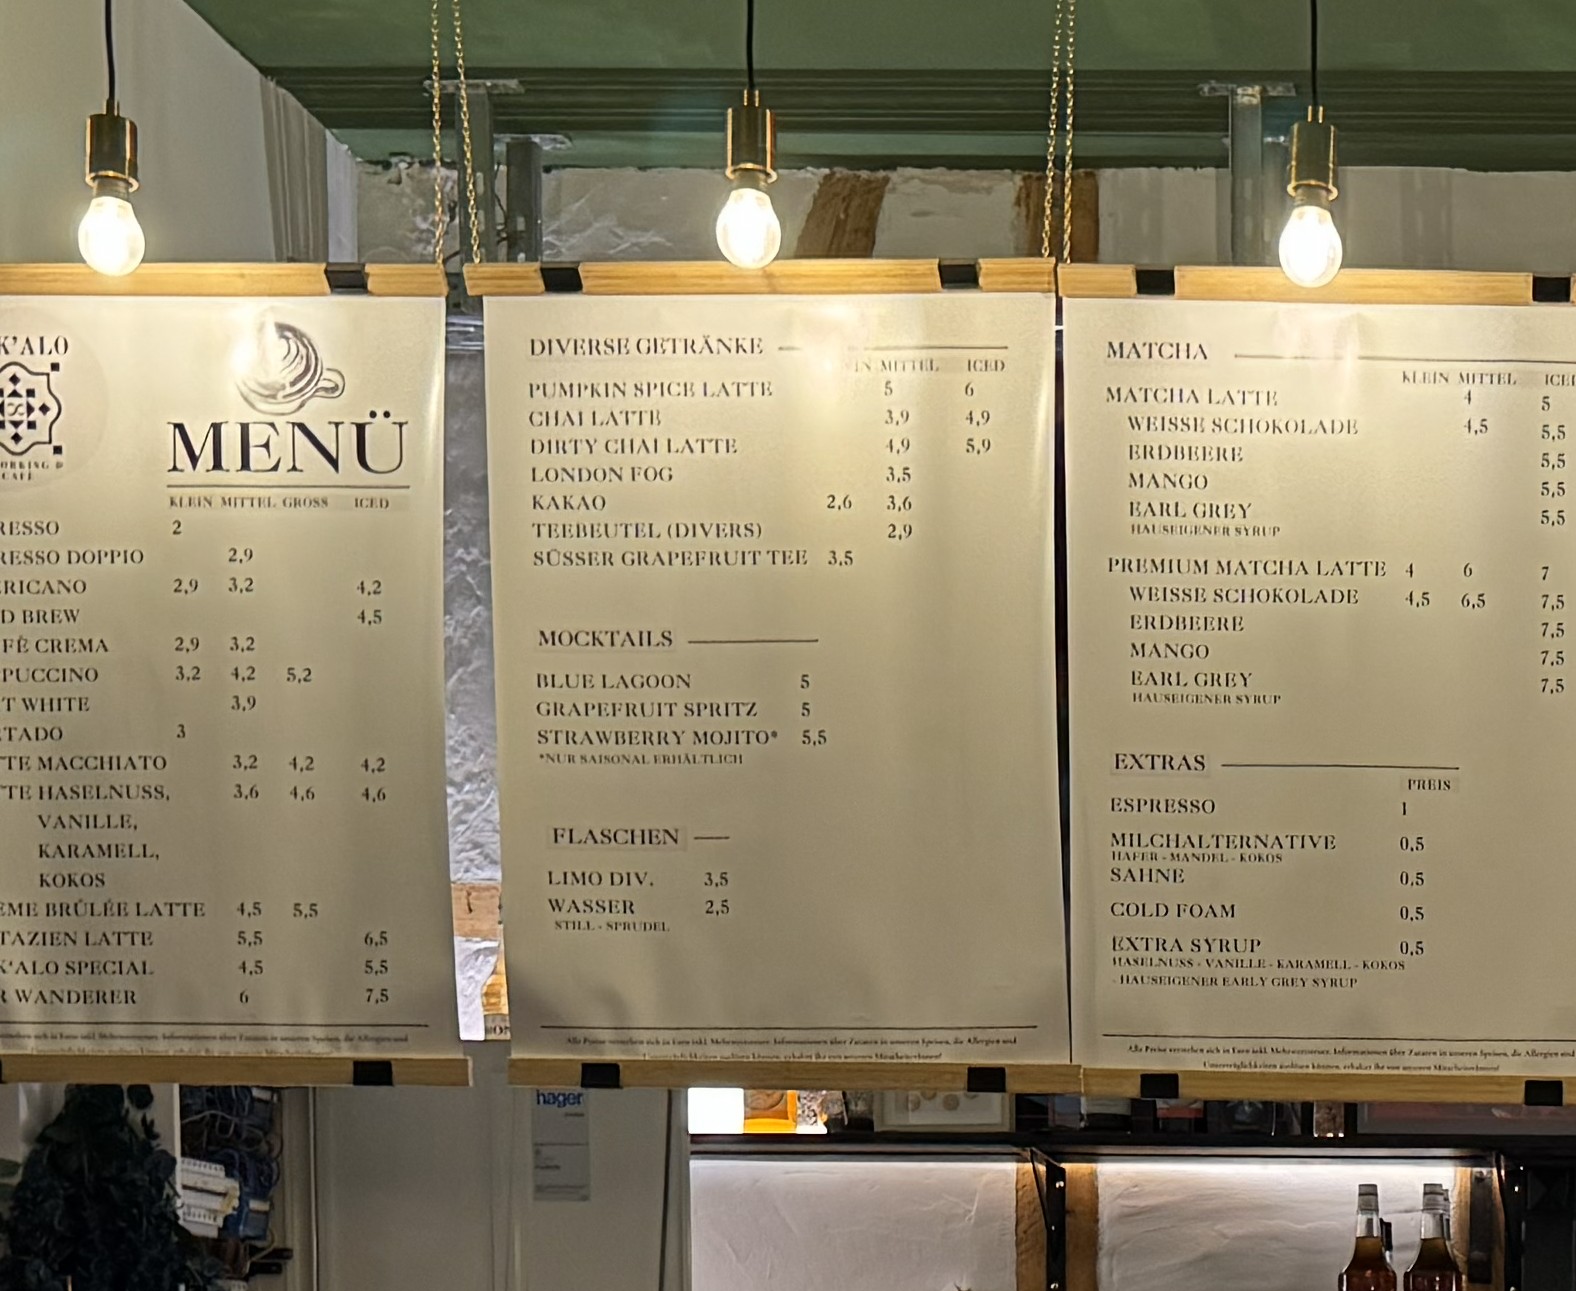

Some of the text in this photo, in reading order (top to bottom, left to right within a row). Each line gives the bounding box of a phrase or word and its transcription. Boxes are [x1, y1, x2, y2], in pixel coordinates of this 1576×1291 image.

[531, 335, 763, 355] DIVERSE GETRÄNKE
[1107, 342, 1207, 360] MATCHA
[1128, 416, 1565, 442] WEISSE SCHOKOLADE 4,5 5,5
[167, 408, 408, 474] MENÜ
[1130, 445, 1565, 470] ERDBEERE 5,5
[1129, 473, 1565, 498] MANGO 5,5
[221, 496, 276, 508] MITTEL
[282, 497, 328, 508] GROSS
[355, 498, 389, 509] ICED
[533, 494, 911, 512] KAKAO 2,6 3,6
[532, 523, 912, 540] TEEBEUTEL (DIVERS) 2,9
[68, 548, 253, 564] DOPPIO 2,9
[534, 549, 853, 566] SÜSSER GRAPEFRUIT TEE 3,5
[1109, 558, 1549, 580] PREMIUM MATCHA LATTE 4 6 7
[35, 636, 255, 653] CREMA 2,9 3,2
[539, 630, 672, 647] MOCKTAILS
[21, 695, 256, 712] WHITE 3,9
[536, 702, 810, 717] GRAPEFRUIT SPRITZ 5
[38, 755, 385, 774] MACCHIATO 3,2 4,2 4,2
[1116, 753, 1205, 771] EXTRAS
[39, 784, 386, 802] HASELNUSS, 3,6 4,6 4,6
[1408, 779, 1450, 790] PREIS
[38, 814, 137, 830] VANILLE,
[554, 828, 678, 845] FLASCHEN
[1111, 833, 1424, 852] MILCHALTERNATIVE 0,5
[39, 844, 159, 860] KARAMELL,
[40, 873, 105, 888] KOKOS
[549, 871, 728, 887] LIMO DIV. 3,5
[1111, 868, 1424, 886] SAHNE 0,5
[548, 899, 729, 916] WASSER 2,5
[1111, 903, 1424, 921] COLD FOAM 0,5
[555, 920, 669, 931] STILL SPRUDEL
[85, 931, 388, 947] LATTE 5,5 6,5
[1113, 936, 1424, 956] EXTRA SYRUP 0,5
[15, 988, 389, 1005] WANDERER 6 7,5
